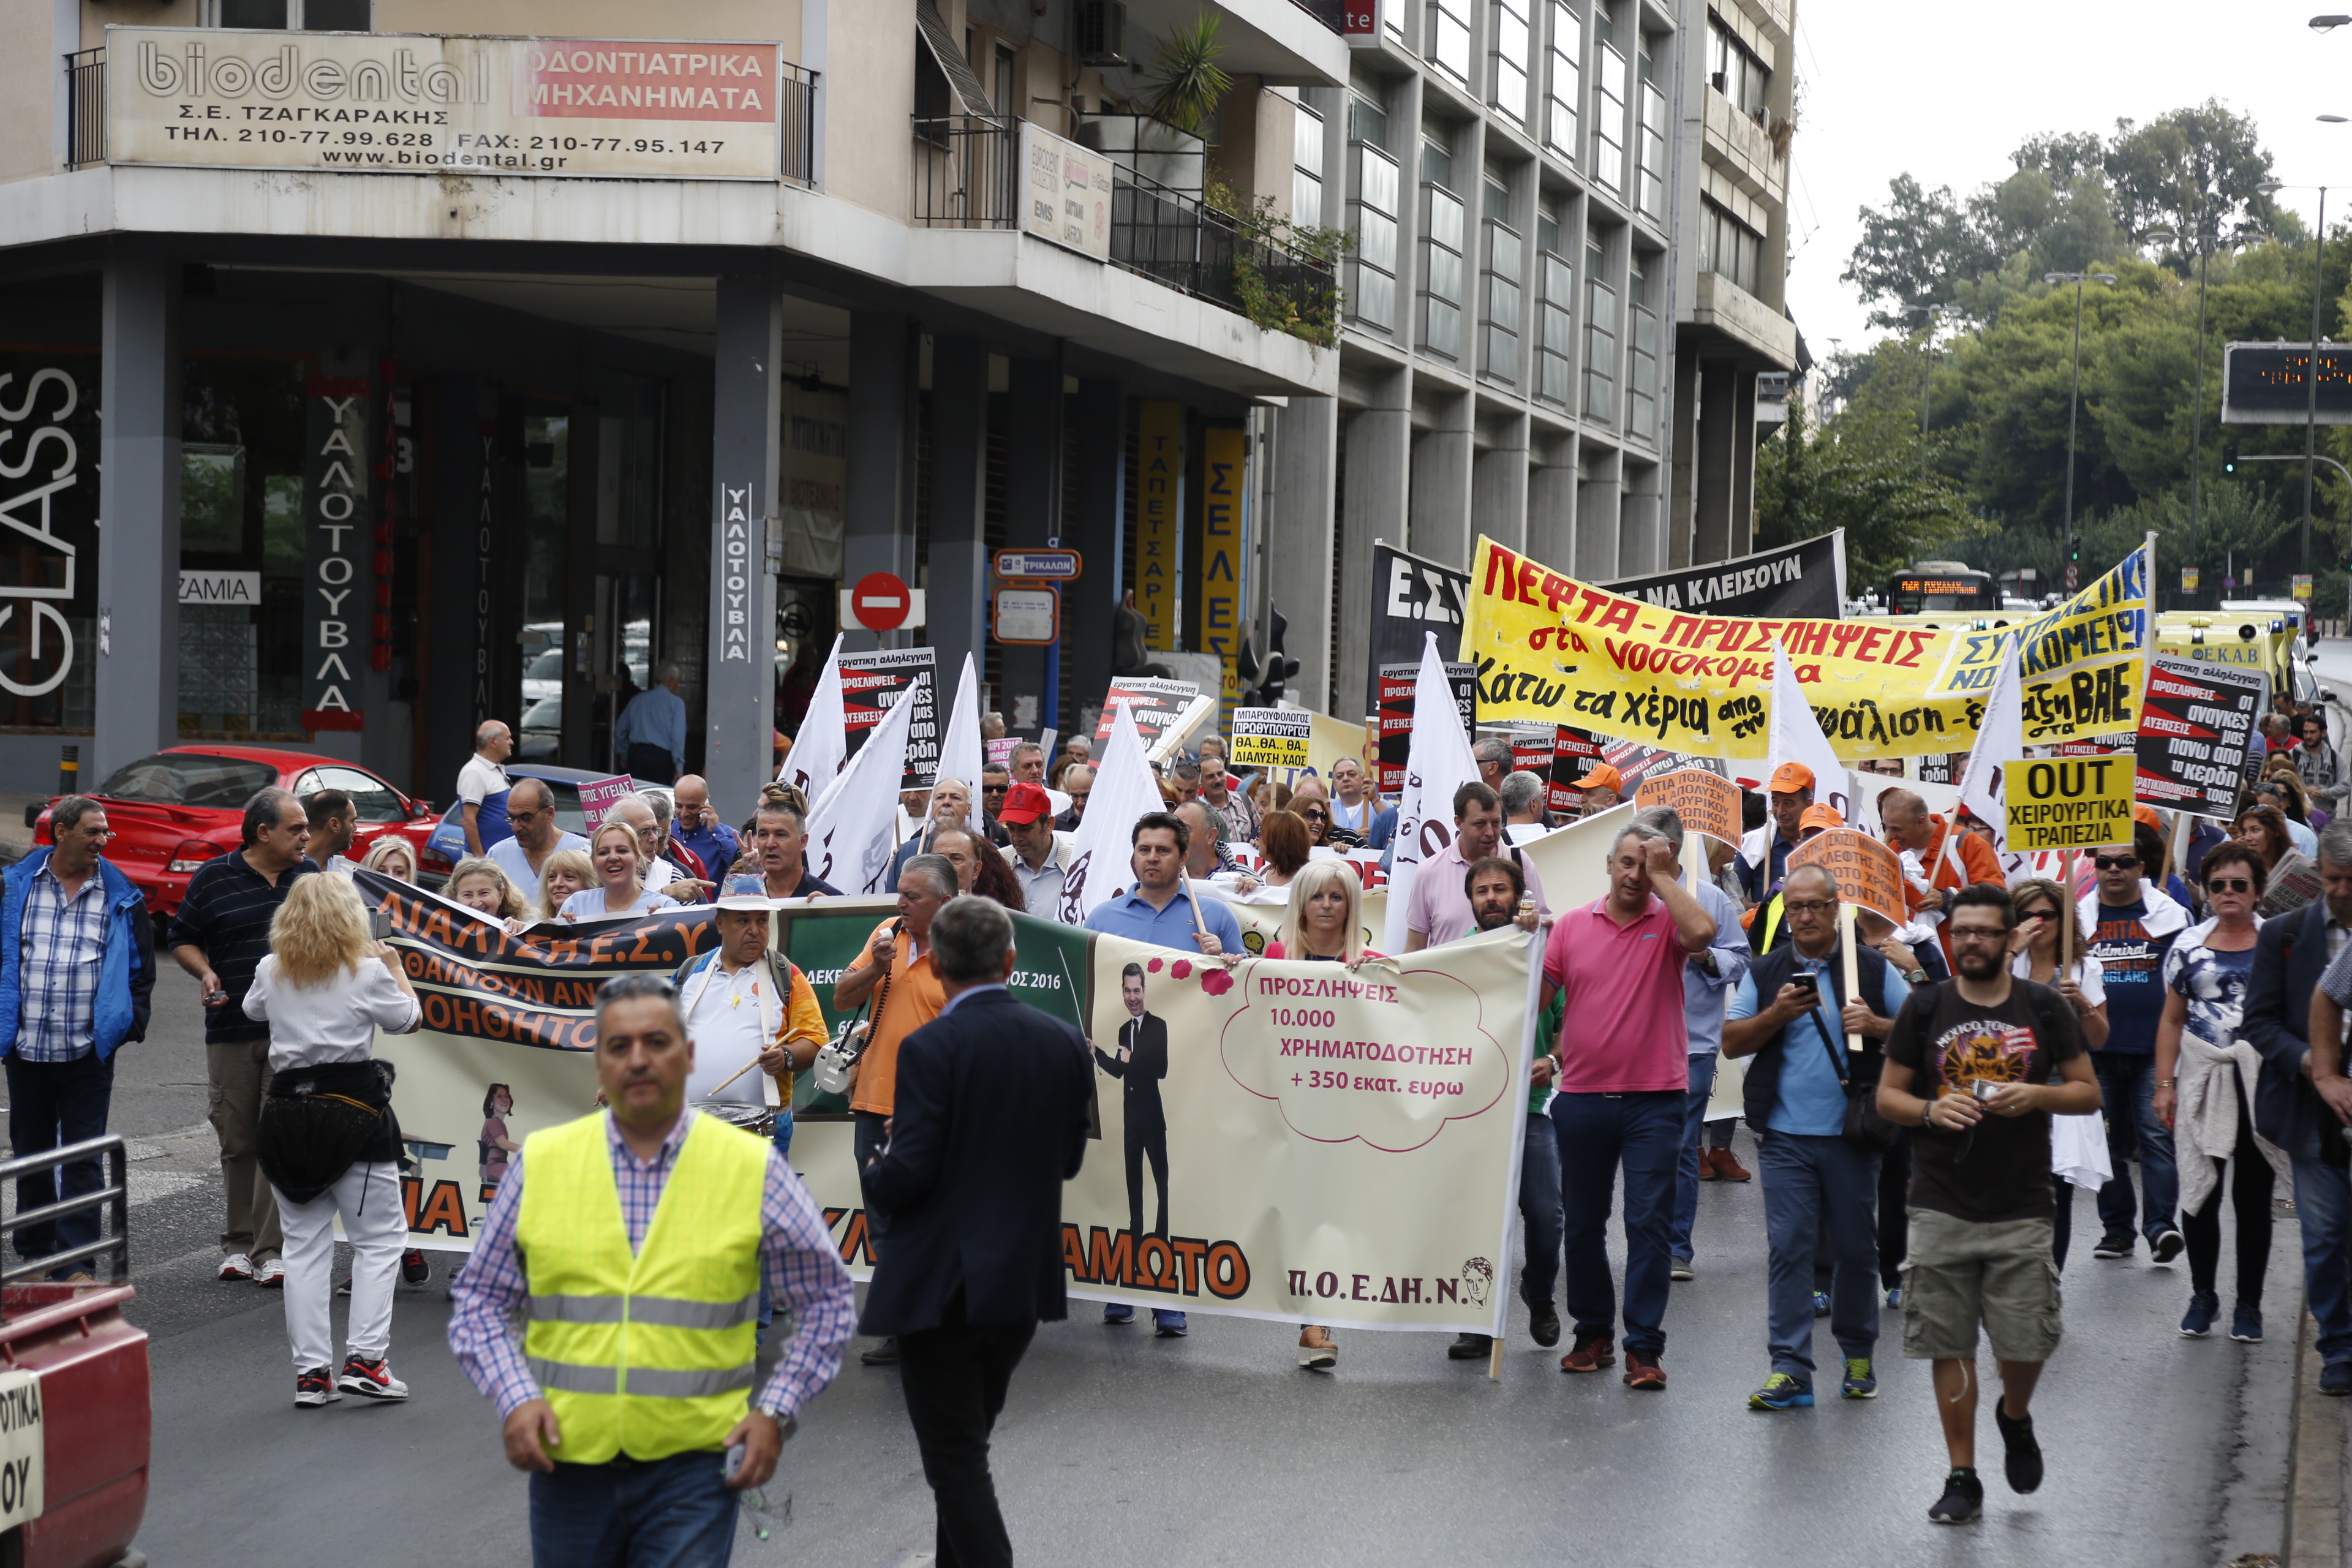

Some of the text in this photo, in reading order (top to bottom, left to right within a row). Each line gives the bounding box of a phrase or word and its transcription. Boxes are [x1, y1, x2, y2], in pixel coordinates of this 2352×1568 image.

[138, 42, 488, 104] biodental
[527, 51, 763, 77] ΟΔΟΝΤΙΑΤΡΙΚΑ
[528, 84, 762, 110] ΜΗΧΑΝΗΜΑΤΑ
[179, 105, 448, 125] Σ.Ε. ΤΖΑΓΚΑΡΑΚΗΣ
[165, 126, 725, 154] ΤΗΛ. 210-77.99.628 FAX: 210-77.95.147
[323, 151, 567, 170] www.biodental.gr
[1035, 200, 1053, 222] EMS
[1144, 435, 1168, 650] ΤΑΠΕΤΣΑΡΙΕ
[316, 396, 354, 712] ΥΑΛΟΤΟΥΒΛΑ
[1024, 560, 1071, 570] ΤΡΙΚΑΛΩΝ
[727, 489, 745, 660] ΥΑΛΟΤΟΥΒΛΑ
[1687, 554, 1801, 606] ΚΛΕΙΣΟΥΝ
[179, 578, 249, 600] ΖΑΜΙΑ
[2152, 679, 2216, 701] ΠΡΟΣΛΗΨΕΙΣ
[1237, 710, 1310, 723] ΜΠΑΡΟΥΦΟΛΟΓΟΣ
[2143, 716, 2192, 735] ΑΥΞΗΣΕΙΣ
[1235, 723, 1309, 737] ΠΡΩΘΥΠΟΥΡΓΟΣ
[1558, 740, 1594, 754] ΑΥΞΗΣΕΙΣ
[2168, 737, 2243, 766] πανω απο
[1235, 752, 1306, 766] ΔΙΑΛΥΣΗ ΧΑΟΣ
[598, 781, 633, 800] ΥΓΕΙΑΣ
[1642, 773, 1736, 797] ΑΙΤΙΑ ΠΟΛΕΜΟΥ
[2027, 760, 2114, 799] OUT
[1669, 785, 1724, 803] ΑΠΟΛΥΣΗ
[2008, 799, 2130, 826] ΧΕΙΡΟΥΡΓΙΚΑ
[2025, 822, 2113, 847] ΤΡΑΠΕΖΙΑ
[1819, 851, 1875, 871] ΚΛΕΦΤΗΣ
[1836, 883, 1891, 913] ΡΟΝΤΑΙ
[2088, 941, 2149, 957] Admiral
[1031, 971, 1061, 990] 2016
[2102, 971, 2149, 983] NGLAND
[1260, 978, 1398, 1003] ΠΡΟΣΛΗΨΕΙΣ
[1271, 1008, 1335, 1028] 10.000
[1280, 1038, 1472, 1065] ΧΡΗΜΑΤΟΔΟΤΗΣΗ
[1309, 1071, 1348, 1089] 350
[1354, 1076, 1402, 1093] εκατ.
[1409, 1080, 1463, 1099] ευρω
